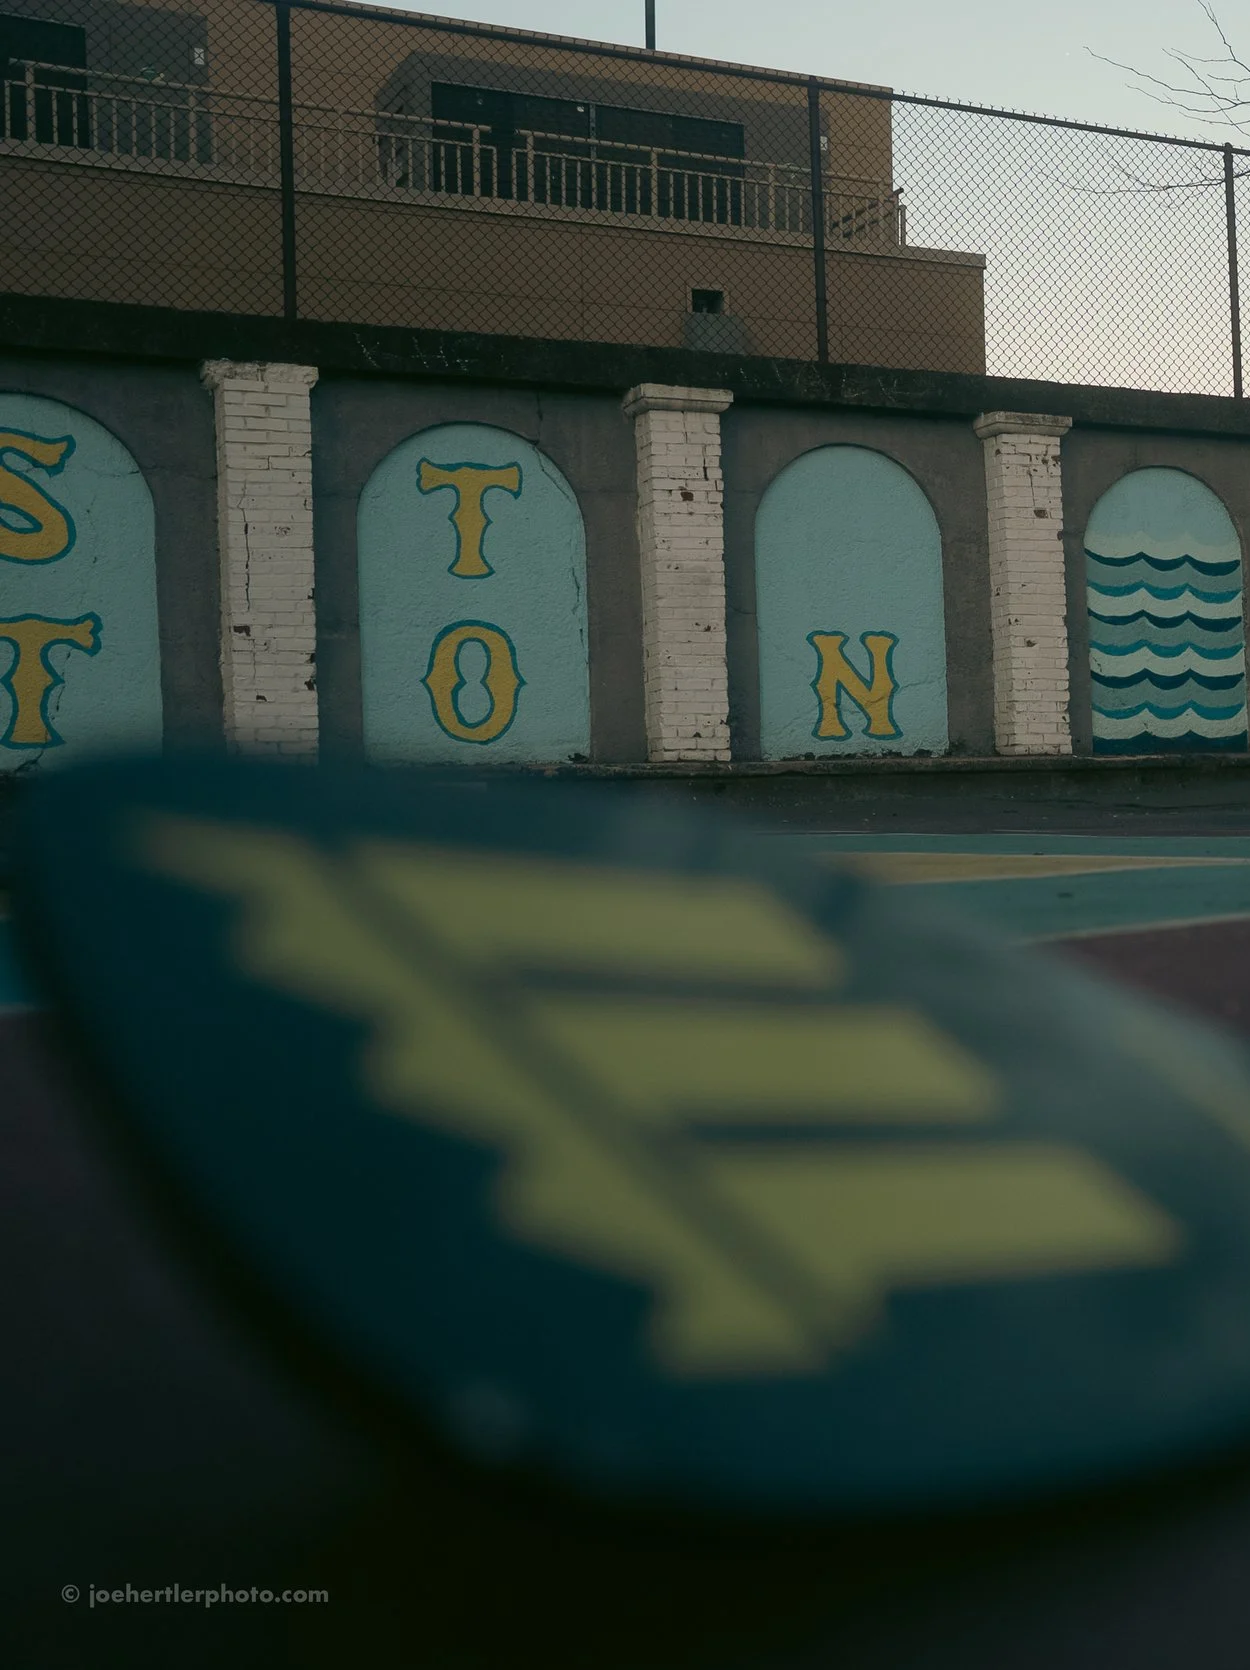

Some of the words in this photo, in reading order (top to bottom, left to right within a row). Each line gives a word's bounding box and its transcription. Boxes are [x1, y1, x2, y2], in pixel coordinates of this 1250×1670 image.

[0, 427, 76, 565] S
[416, 457, 522, 579] T
[0, 612, 102, 749] T
[420, 620, 527, 745] O
[806, 630, 903, 741] N
